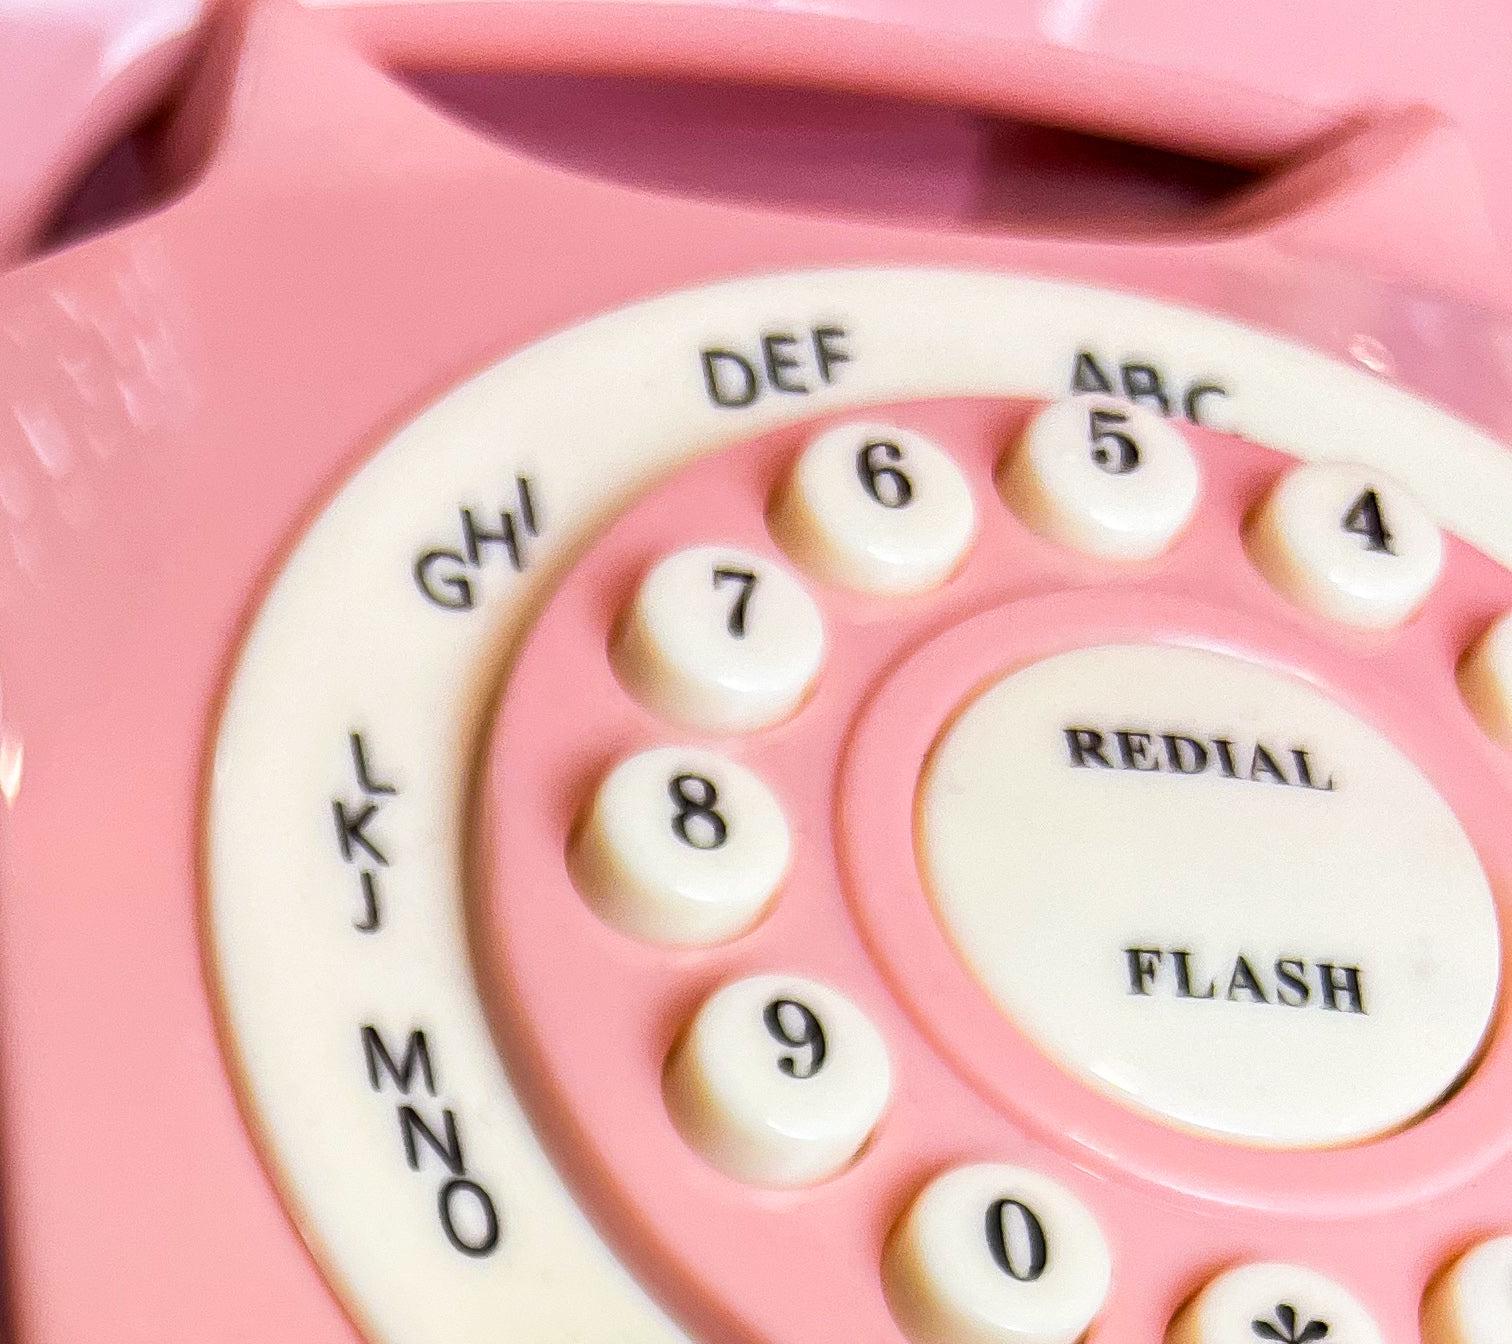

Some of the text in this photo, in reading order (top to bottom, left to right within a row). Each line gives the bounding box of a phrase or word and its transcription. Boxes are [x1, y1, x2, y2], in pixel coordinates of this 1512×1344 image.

[700, 326, 854, 409] DEF
[856, 440, 915, 510] 6
[1088, 408, 1142, 474] 5
[414, 474, 541, 612] GHI
[1342, 486, 1399, 556] 4
[711, 566, 758, 639] 7
[1061, 724, 1338, 794] REDIAL
[667, 772, 729, 850] 8
[1123, 945, 1369, 1015] FLASH
[762, 997, 828, 1080] 9
[359, 1024, 501, 1259] MNO
[984, 1197, 1049, 1283] 0
